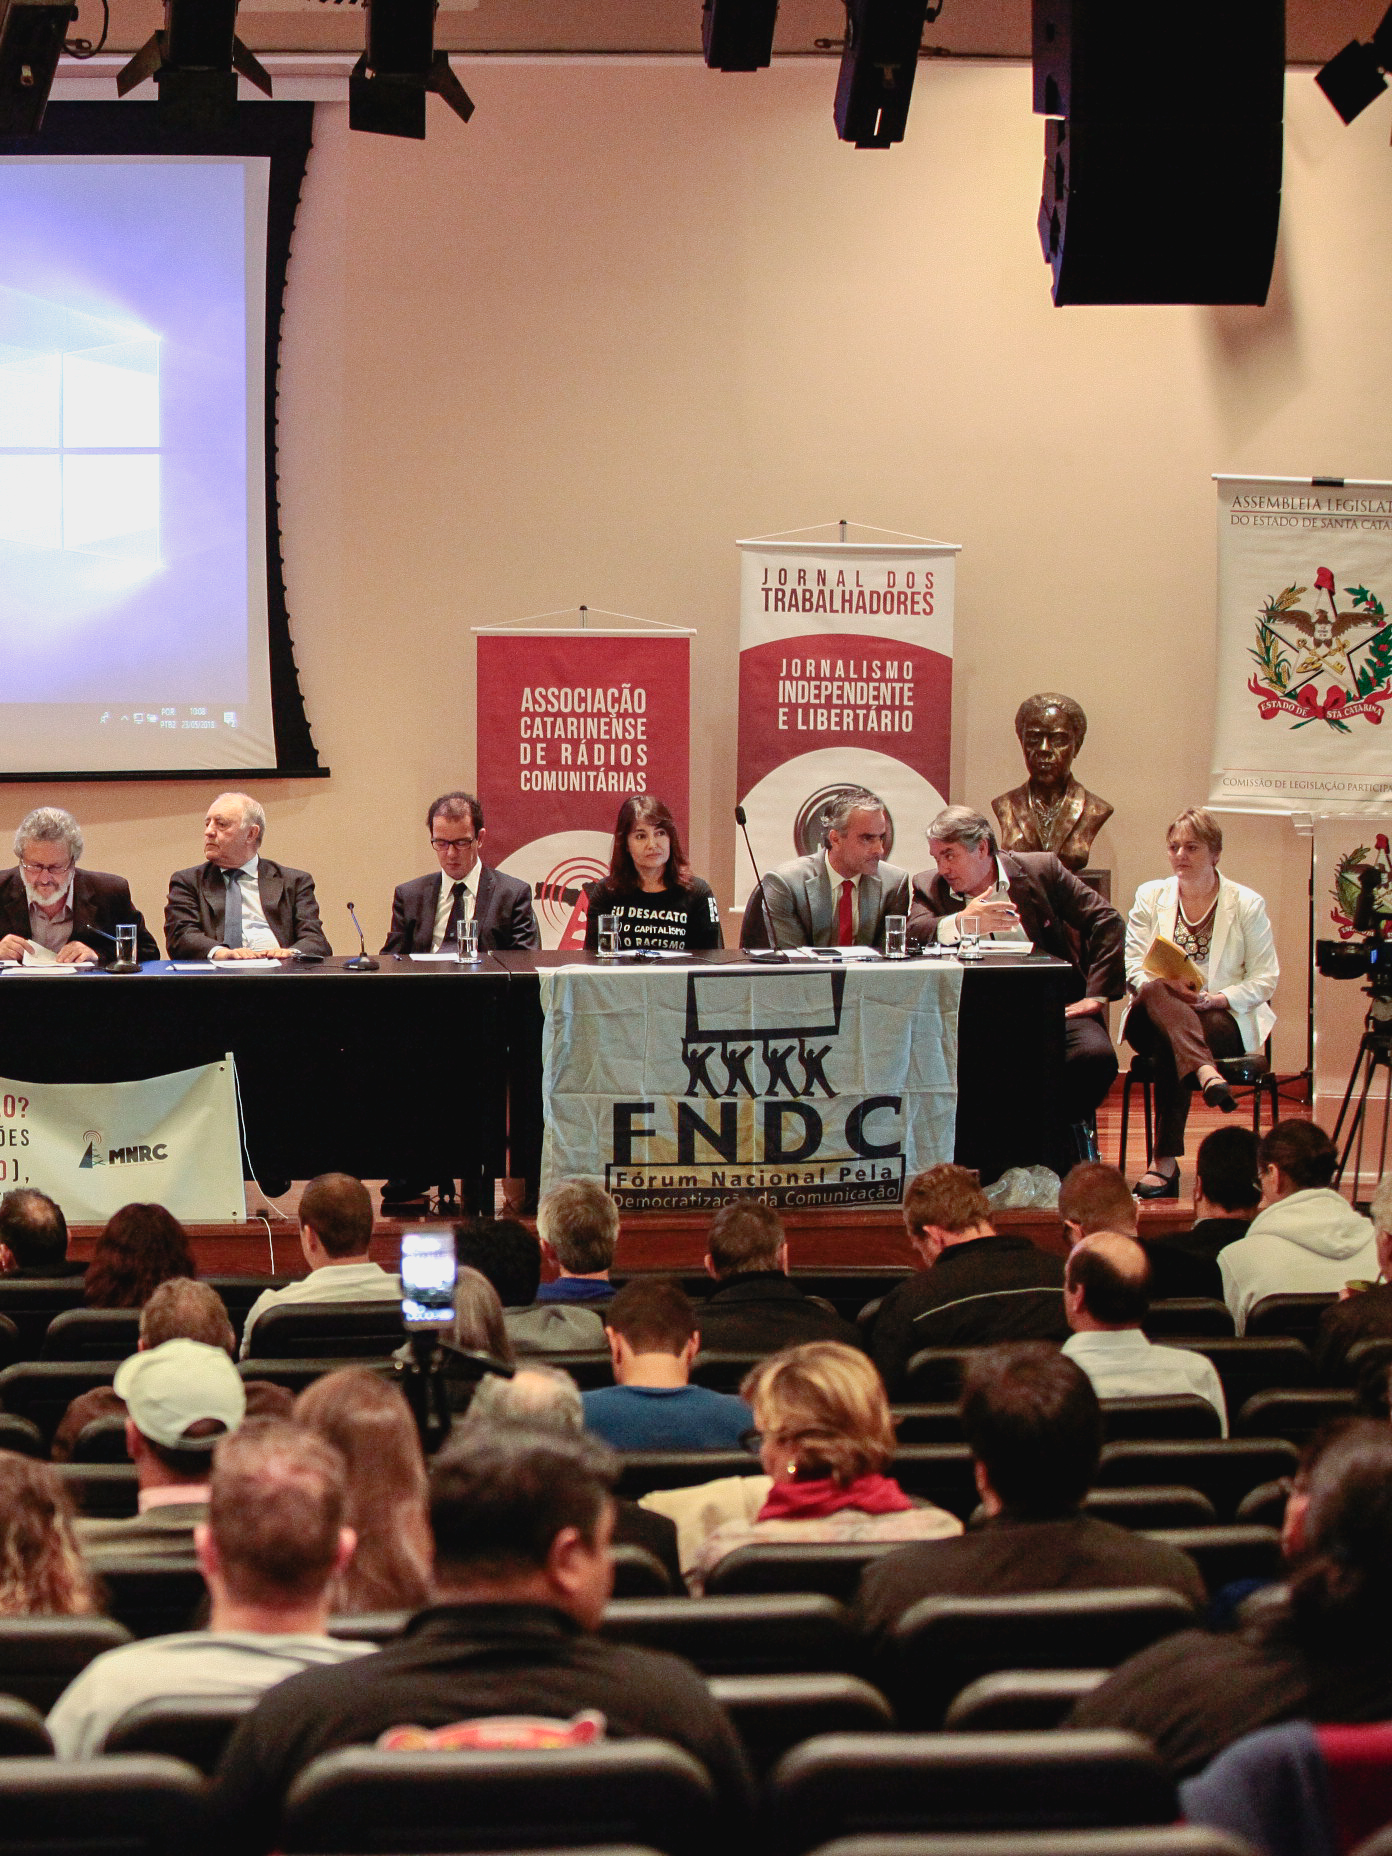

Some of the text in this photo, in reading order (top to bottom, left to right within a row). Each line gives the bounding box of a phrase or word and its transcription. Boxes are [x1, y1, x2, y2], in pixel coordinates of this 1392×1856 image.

[1232, 495, 1322, 511] ASSEMBLEIA
[1230, 514, 1250, 526] DO
[1253, 515, 1299, 528] ESTADO
[1302, 517, 1317, 529] DE
[1321, 518, 1358, 530] SANTA
[762, 567, 934, 589] JORNAL DOS
[761, 588, 935, 616] TRABALHADORES
[780, 658, 913, 679] JORNALISMO
[520, 683, 647, 717] ASSOCIAÇÃO
[778, 680, 914, 706] INDEPENDENTE
[778, 706, 913, 732] E LIBERTÁRIO
[1261, 700, 1296, 715] ESTADO
[1296, 706, 1308, 717] DE
[1344, 703, 1382, 717] CATARINA
[520, 717, 647, 740] CATARINENSE
[520, 739, 648, 766] DE RÁDIOS
[520, 767, 647, 792] COMUNITÁRIAS
[1222, 777, 1272, 788] COMISSÃO
[1275, 780, 1287, 789] DE
[1289, 780, 1345, 791] LEGISLAÇÃO
[628, 906, 688, 924] DESACATO
[613, 1096, 903, 1165] FNDC
[109, 1143, 169, 1165] MNRC
[616, 1163, 892, 1188] Fórum Nacional Pela
[757, 1191, 778, 1208] da
[785, 1183, 897, 1208] Comunicação
